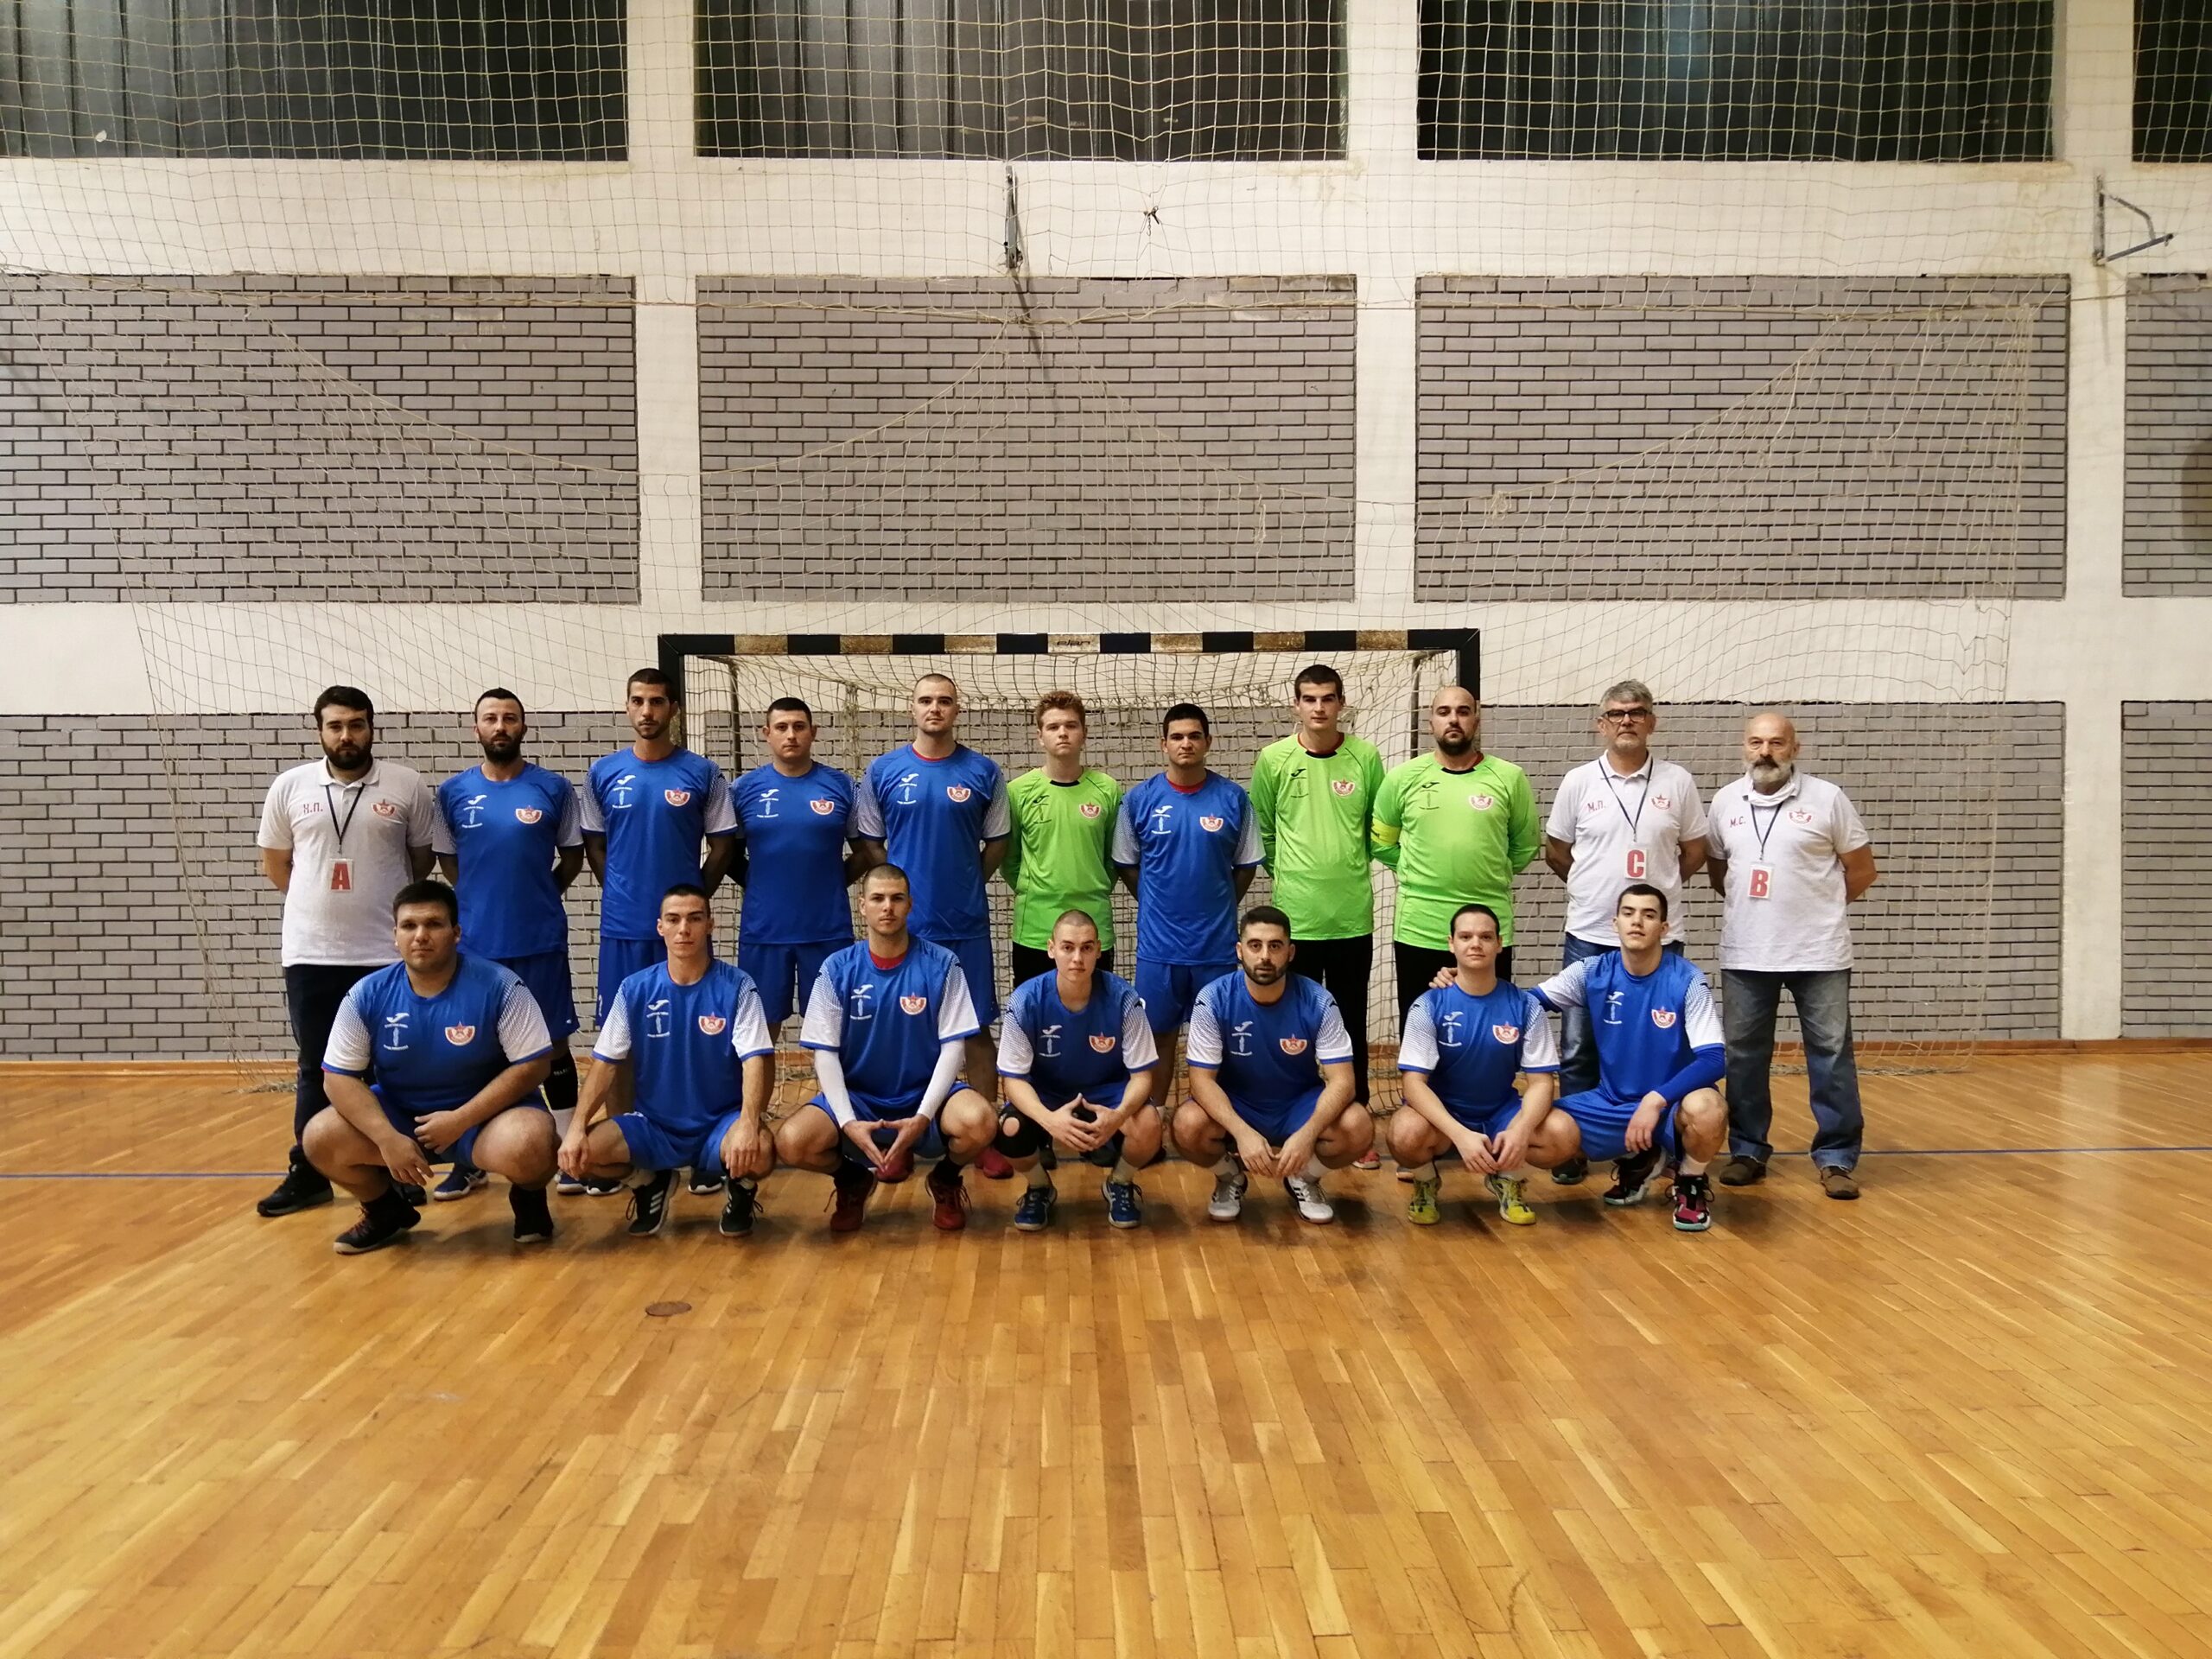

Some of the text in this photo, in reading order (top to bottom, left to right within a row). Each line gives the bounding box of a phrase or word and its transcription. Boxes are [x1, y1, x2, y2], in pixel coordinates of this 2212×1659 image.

[331, 861, 351, 890] A
[1627, 849, 1645, 878] C
[1750, 868, 1769, 897] B
